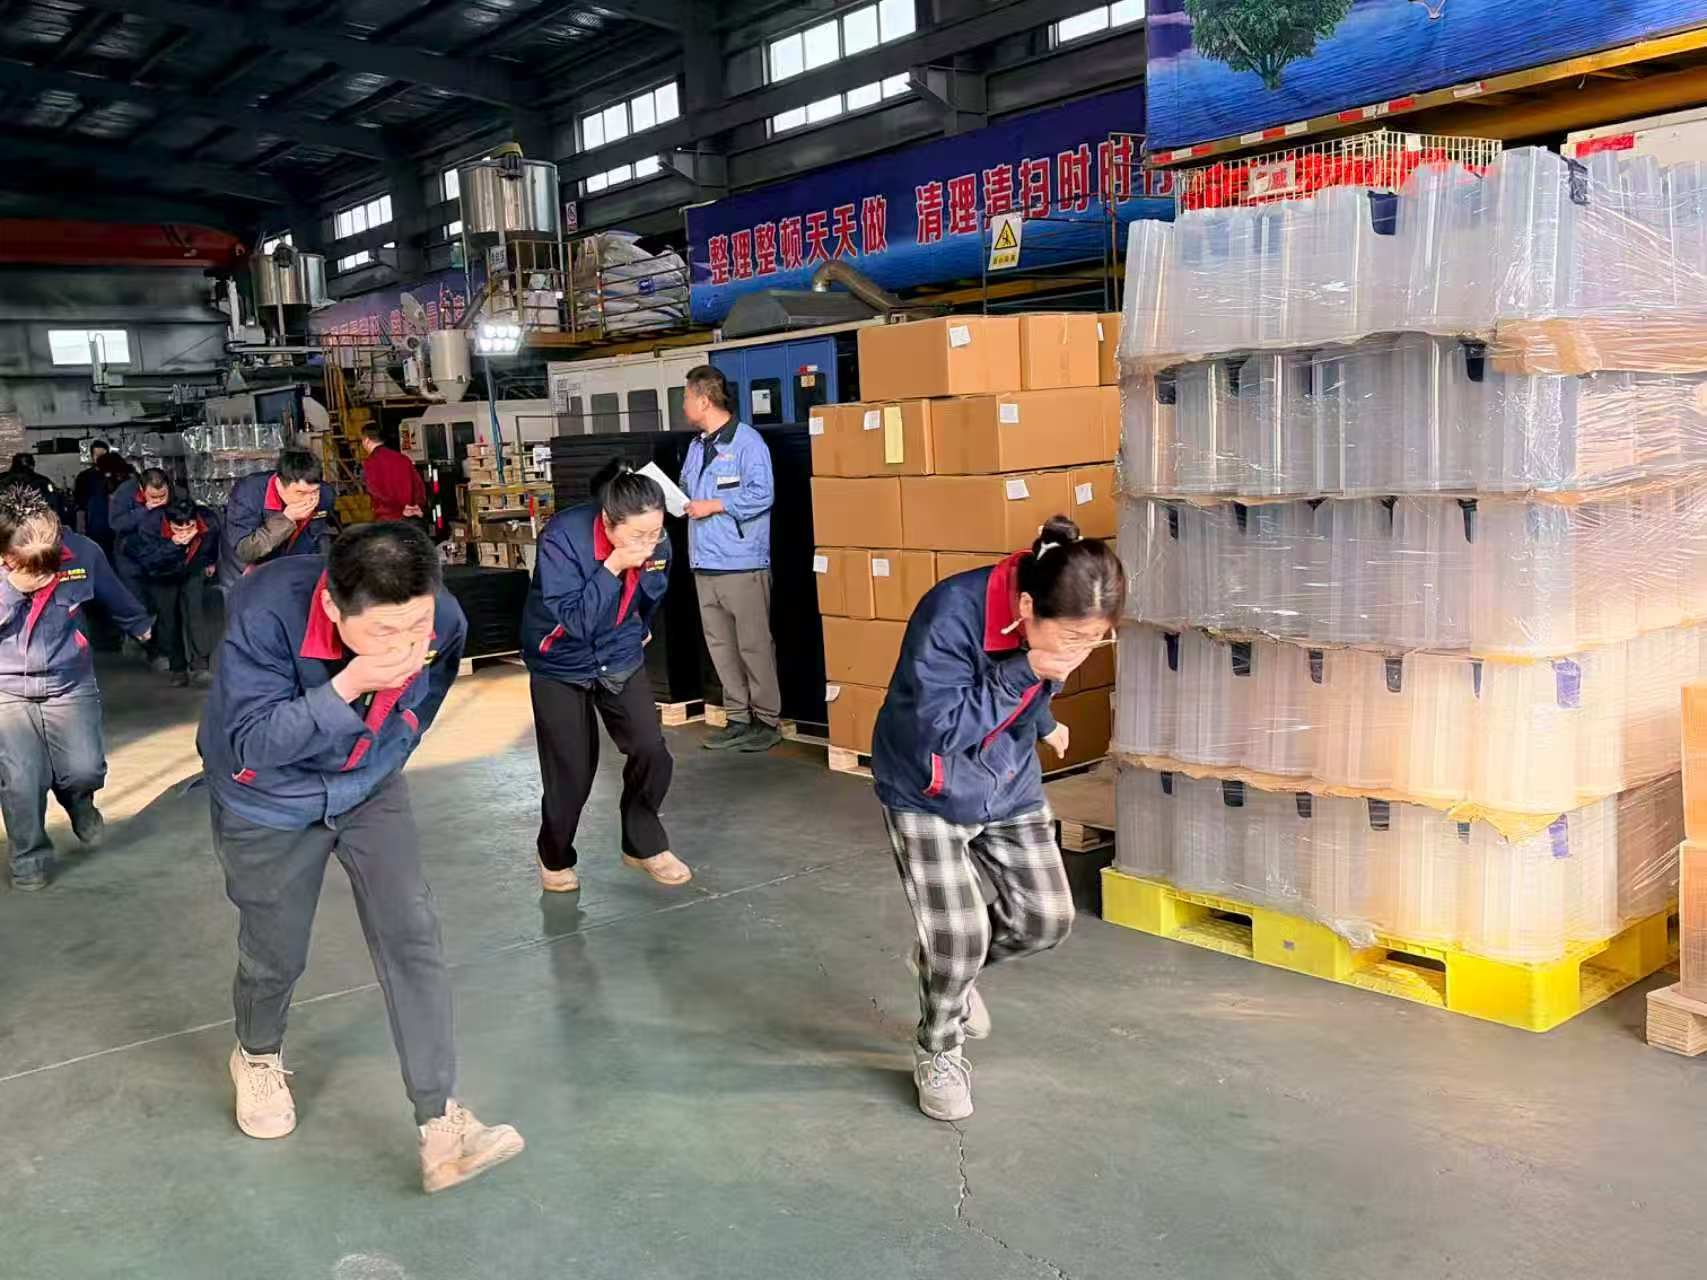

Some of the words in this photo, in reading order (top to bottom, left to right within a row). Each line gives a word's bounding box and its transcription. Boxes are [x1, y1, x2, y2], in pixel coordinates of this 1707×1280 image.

[708, 194, 888, 286] 整理整顿天天做
